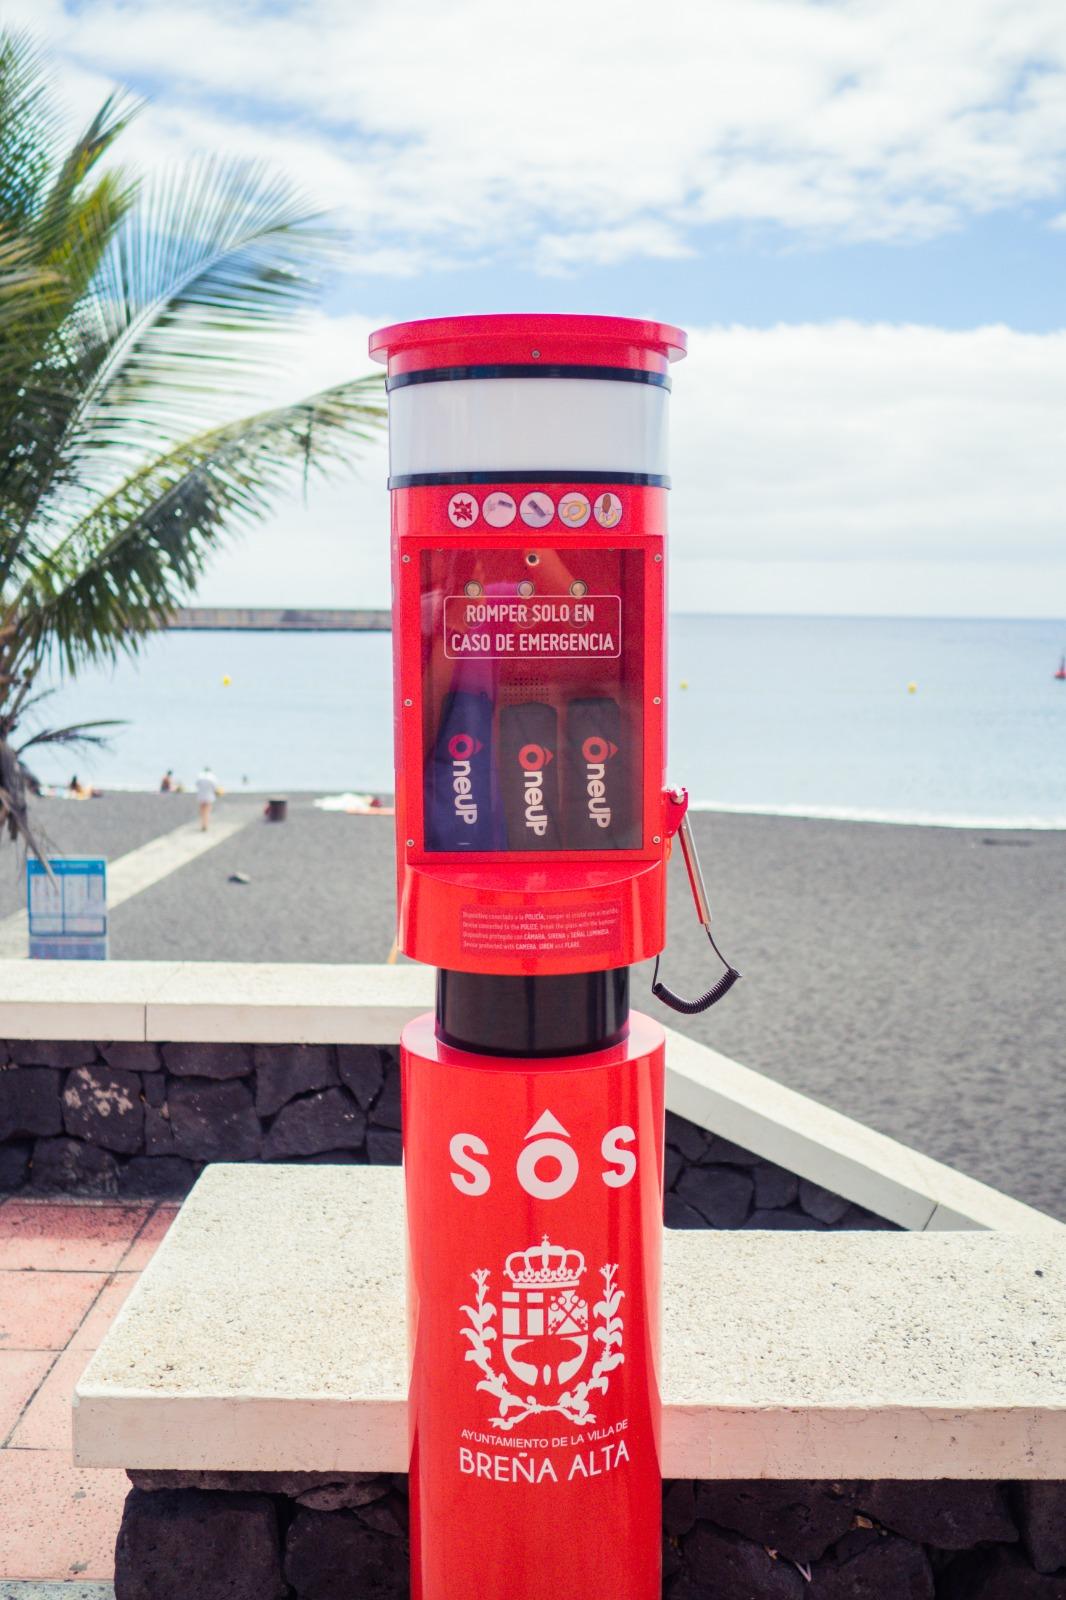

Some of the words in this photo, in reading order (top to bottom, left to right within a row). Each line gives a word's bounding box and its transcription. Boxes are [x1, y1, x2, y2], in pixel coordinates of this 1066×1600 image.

[466, 604, 528, 622] ROMPER
[532, 604, 570, 622] SOLO
[574, 604, 595, 622] EN
[451, 633, 491, 651] CASO
[495, 633, 515, 651] DE
[519, 633, 615, 651] EMERGENCIA
[461, 1429, 548, 1449] AYUNTAMIENTO
[552, 1437, 568, 1448] DE
[571, 1434, 585, 1445] LA
[587, 1426, 614, 1442] VILLA
[616, 1419, 629, 1433] DE
[459, 1446, 558, 1484] BREÑA
[568, 1440, 630, 1481] ALTA
